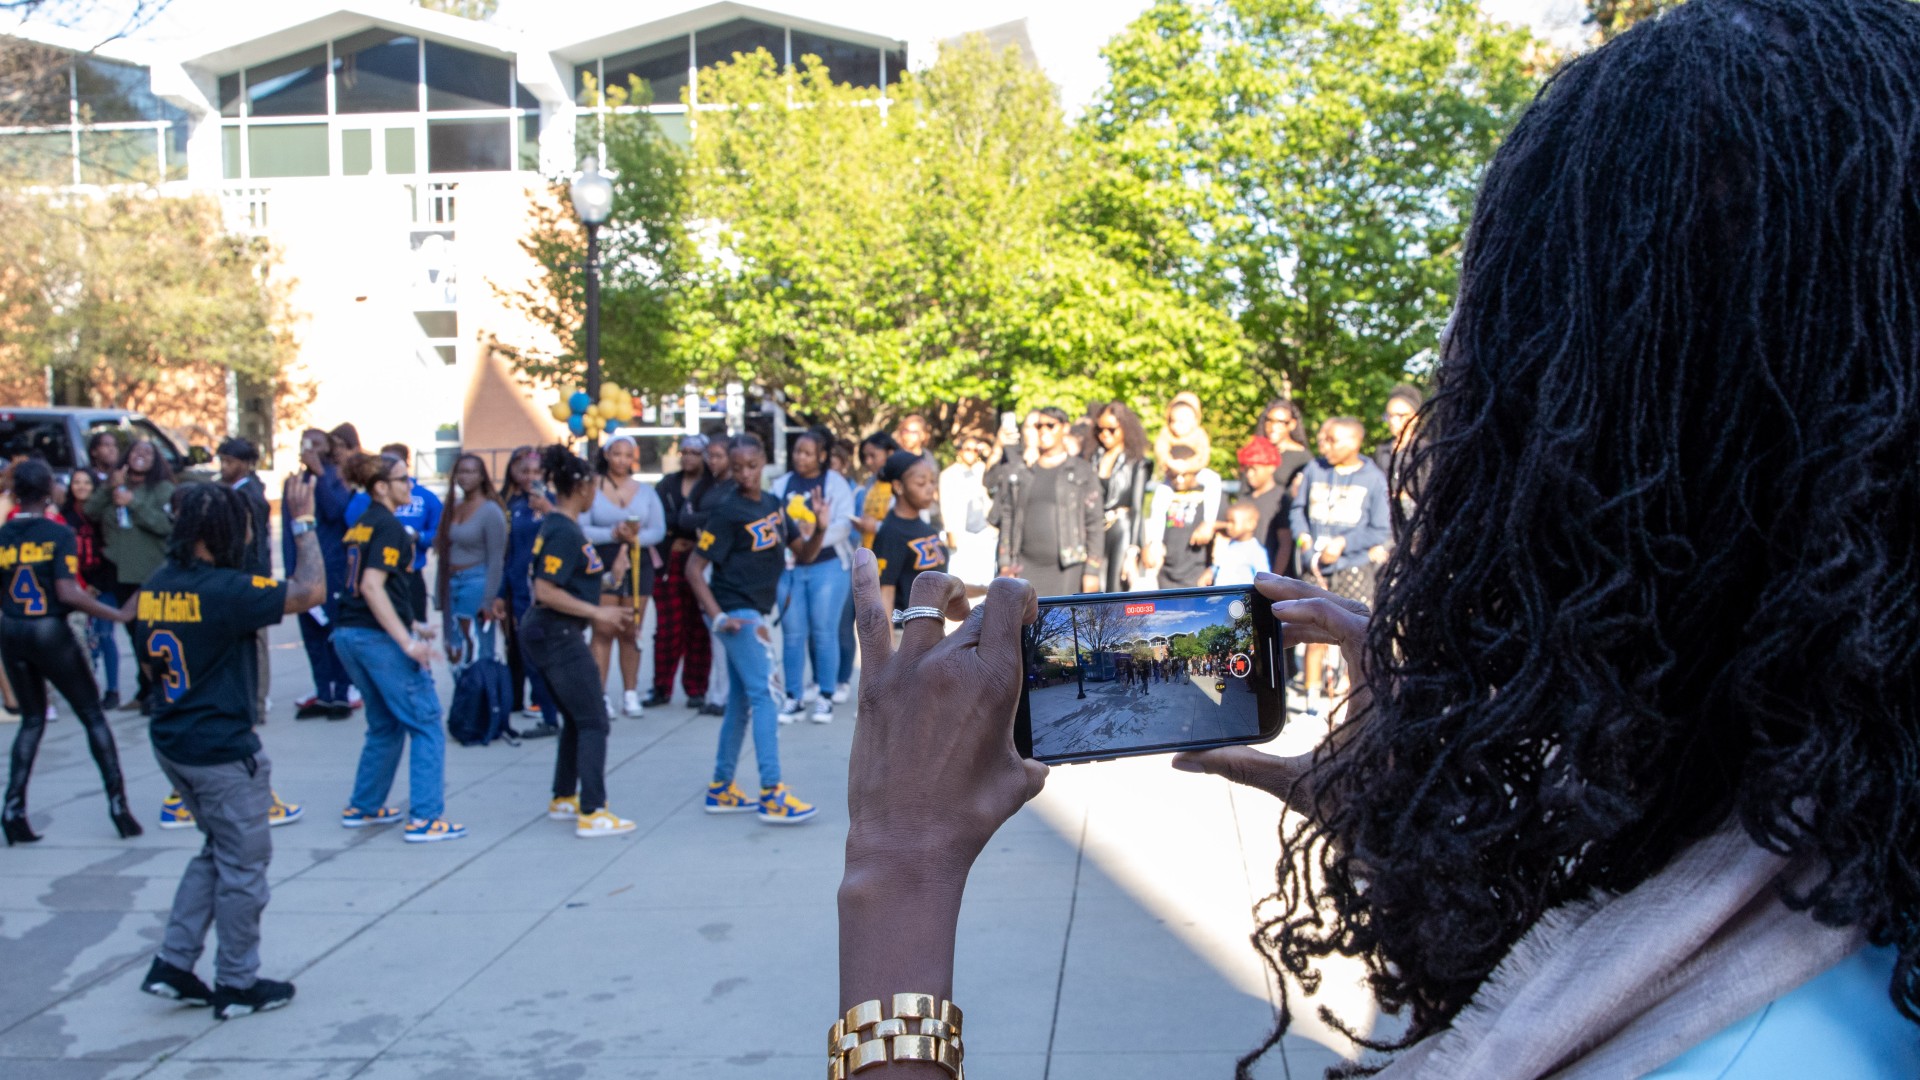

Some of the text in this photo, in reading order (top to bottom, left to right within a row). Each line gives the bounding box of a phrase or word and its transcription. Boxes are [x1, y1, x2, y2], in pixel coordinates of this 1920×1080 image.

[9, 565, 48, 616] 4
[1126, 605, 1154, 614] 00:00:33
[147, 629, 191, 703] 3
